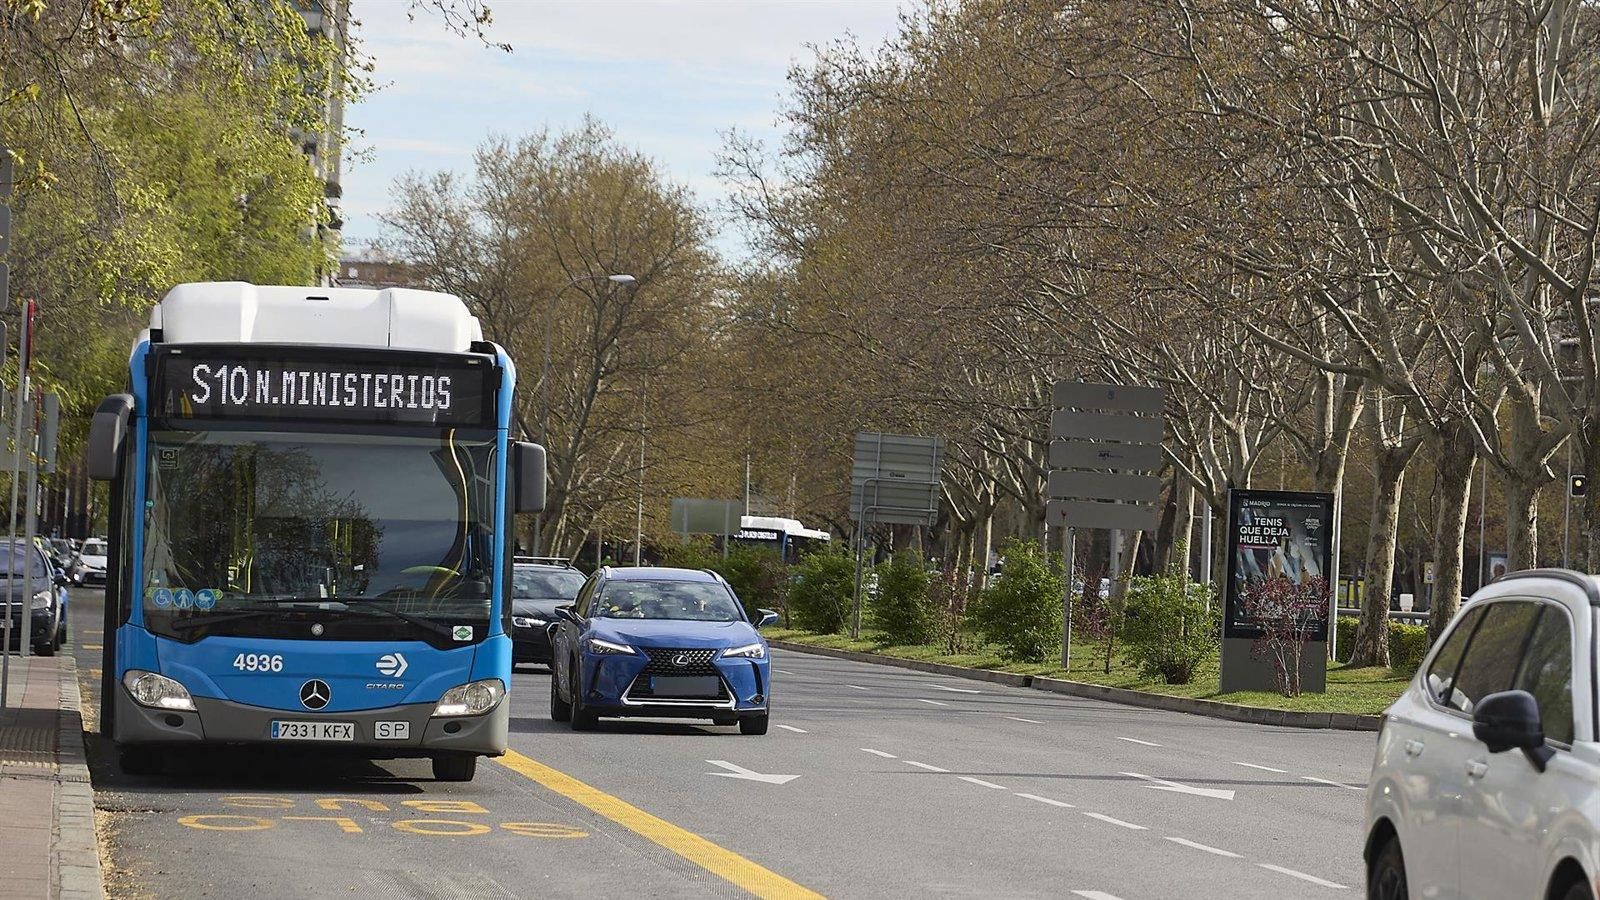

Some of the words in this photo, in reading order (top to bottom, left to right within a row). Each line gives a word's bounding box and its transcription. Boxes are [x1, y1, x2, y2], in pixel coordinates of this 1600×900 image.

[192, 364, 248, 404] S10
[1254, 518, 1282, 527] TENIS
[1240, 526, 1261, 534] QUE
[1263, 528, 1289, 536] DEJA
[1240, 535, 1278, 545] HUELLA
[233, 653, 284, 673] 4936
[281, 723, 317, 738] 7331
[323, 725, 351, 739] KFX
[176, 813, 590, 838] SOLO
